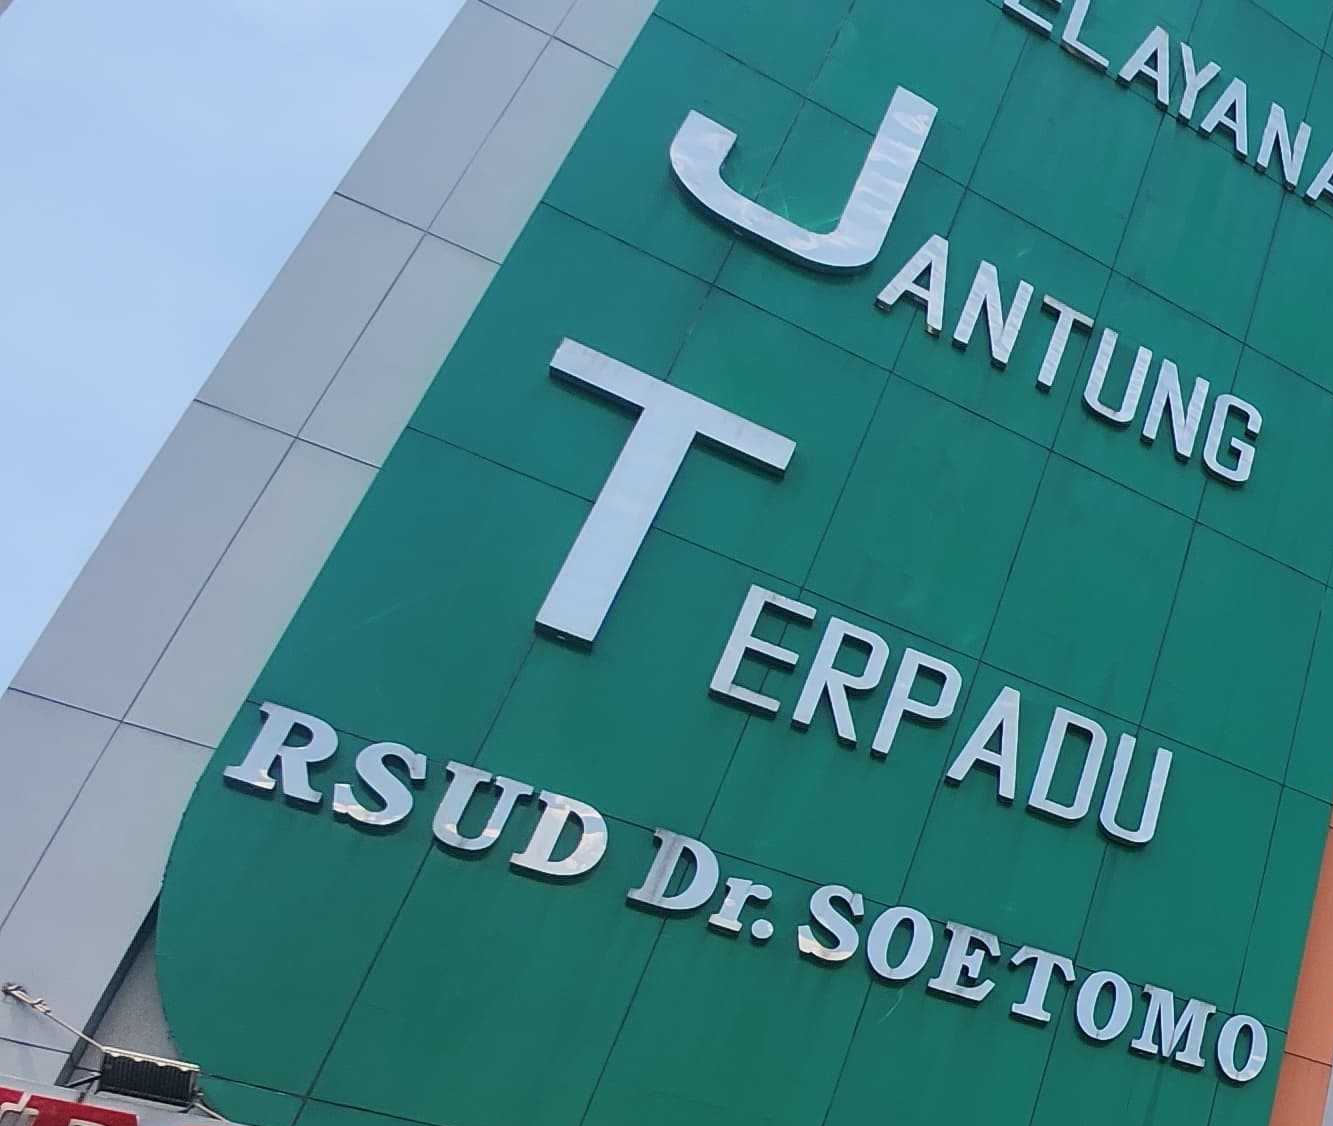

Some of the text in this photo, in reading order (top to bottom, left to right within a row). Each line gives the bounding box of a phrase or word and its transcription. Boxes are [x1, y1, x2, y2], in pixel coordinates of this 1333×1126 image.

[670, 85, 1262, 486] JANTUNG
[535, 337, 1174, 848] TERPADU
[223, 700, 1268, 1082] RSUD Dr. SOETOMO
